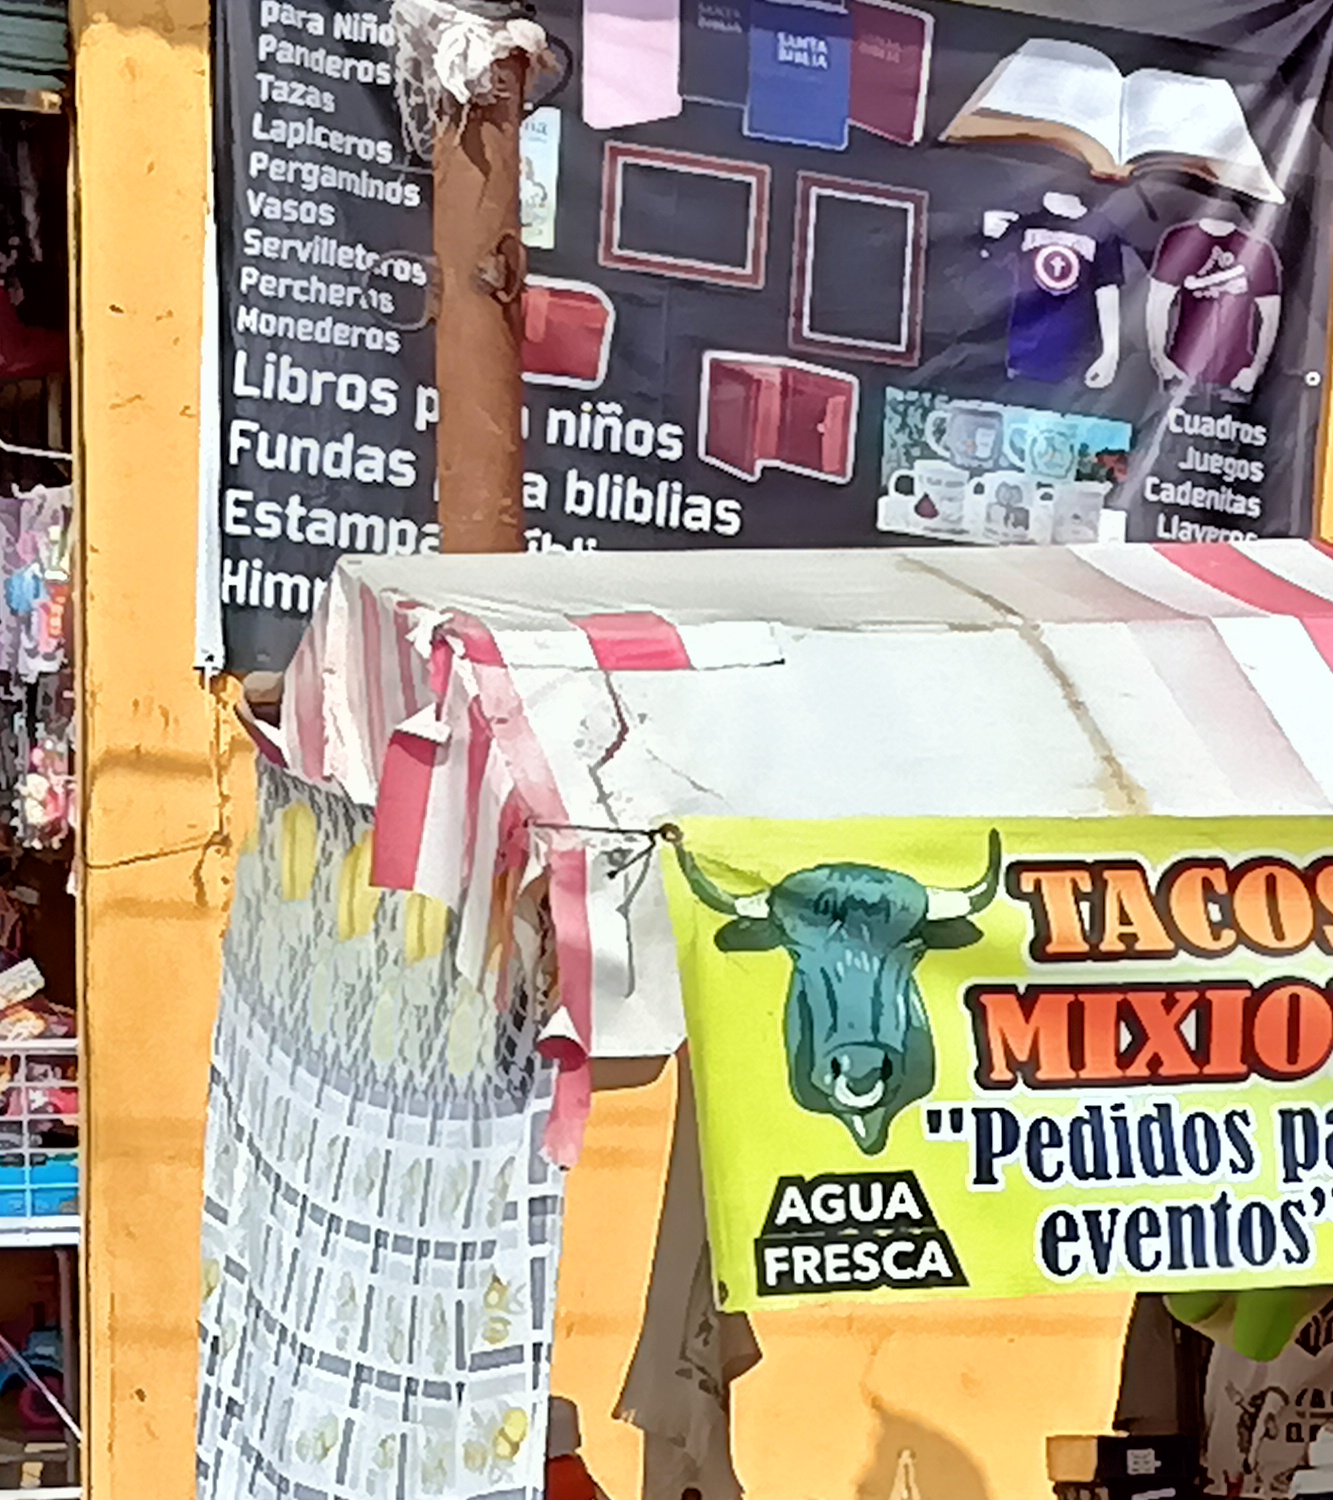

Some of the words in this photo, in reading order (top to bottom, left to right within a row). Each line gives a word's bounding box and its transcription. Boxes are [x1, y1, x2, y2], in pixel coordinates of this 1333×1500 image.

[260, 0, 325, 36] para
[333, 12, 396, 47] Niño
[258, 34, 391, 85] Panderos
[256, 72, 336, 113] Tazas
[252, 112, 393, 164] Lapiceros
[249, 152, 421, 207] Pergaminos
[246, 188, 336, 226] Vasos
[237, 305, 401, 354] Monederos
[233, 350, 400, 416] Libros
[546, 401, 685, 461] niños
[1167, 407, 1267, 446] Cuadros
[228, 419, 416, 487] Fundas
[1178, 446, 1265, 482] Juegos
[224, 488, 442, 555] Estampa
[564, 468, 743, 536] bliblias
[1144, 476, 1262, 518] Cadenitas
[774, 1181, 924, 1226] AGUA
[764, 1240, 954, 1286] FRESCA
